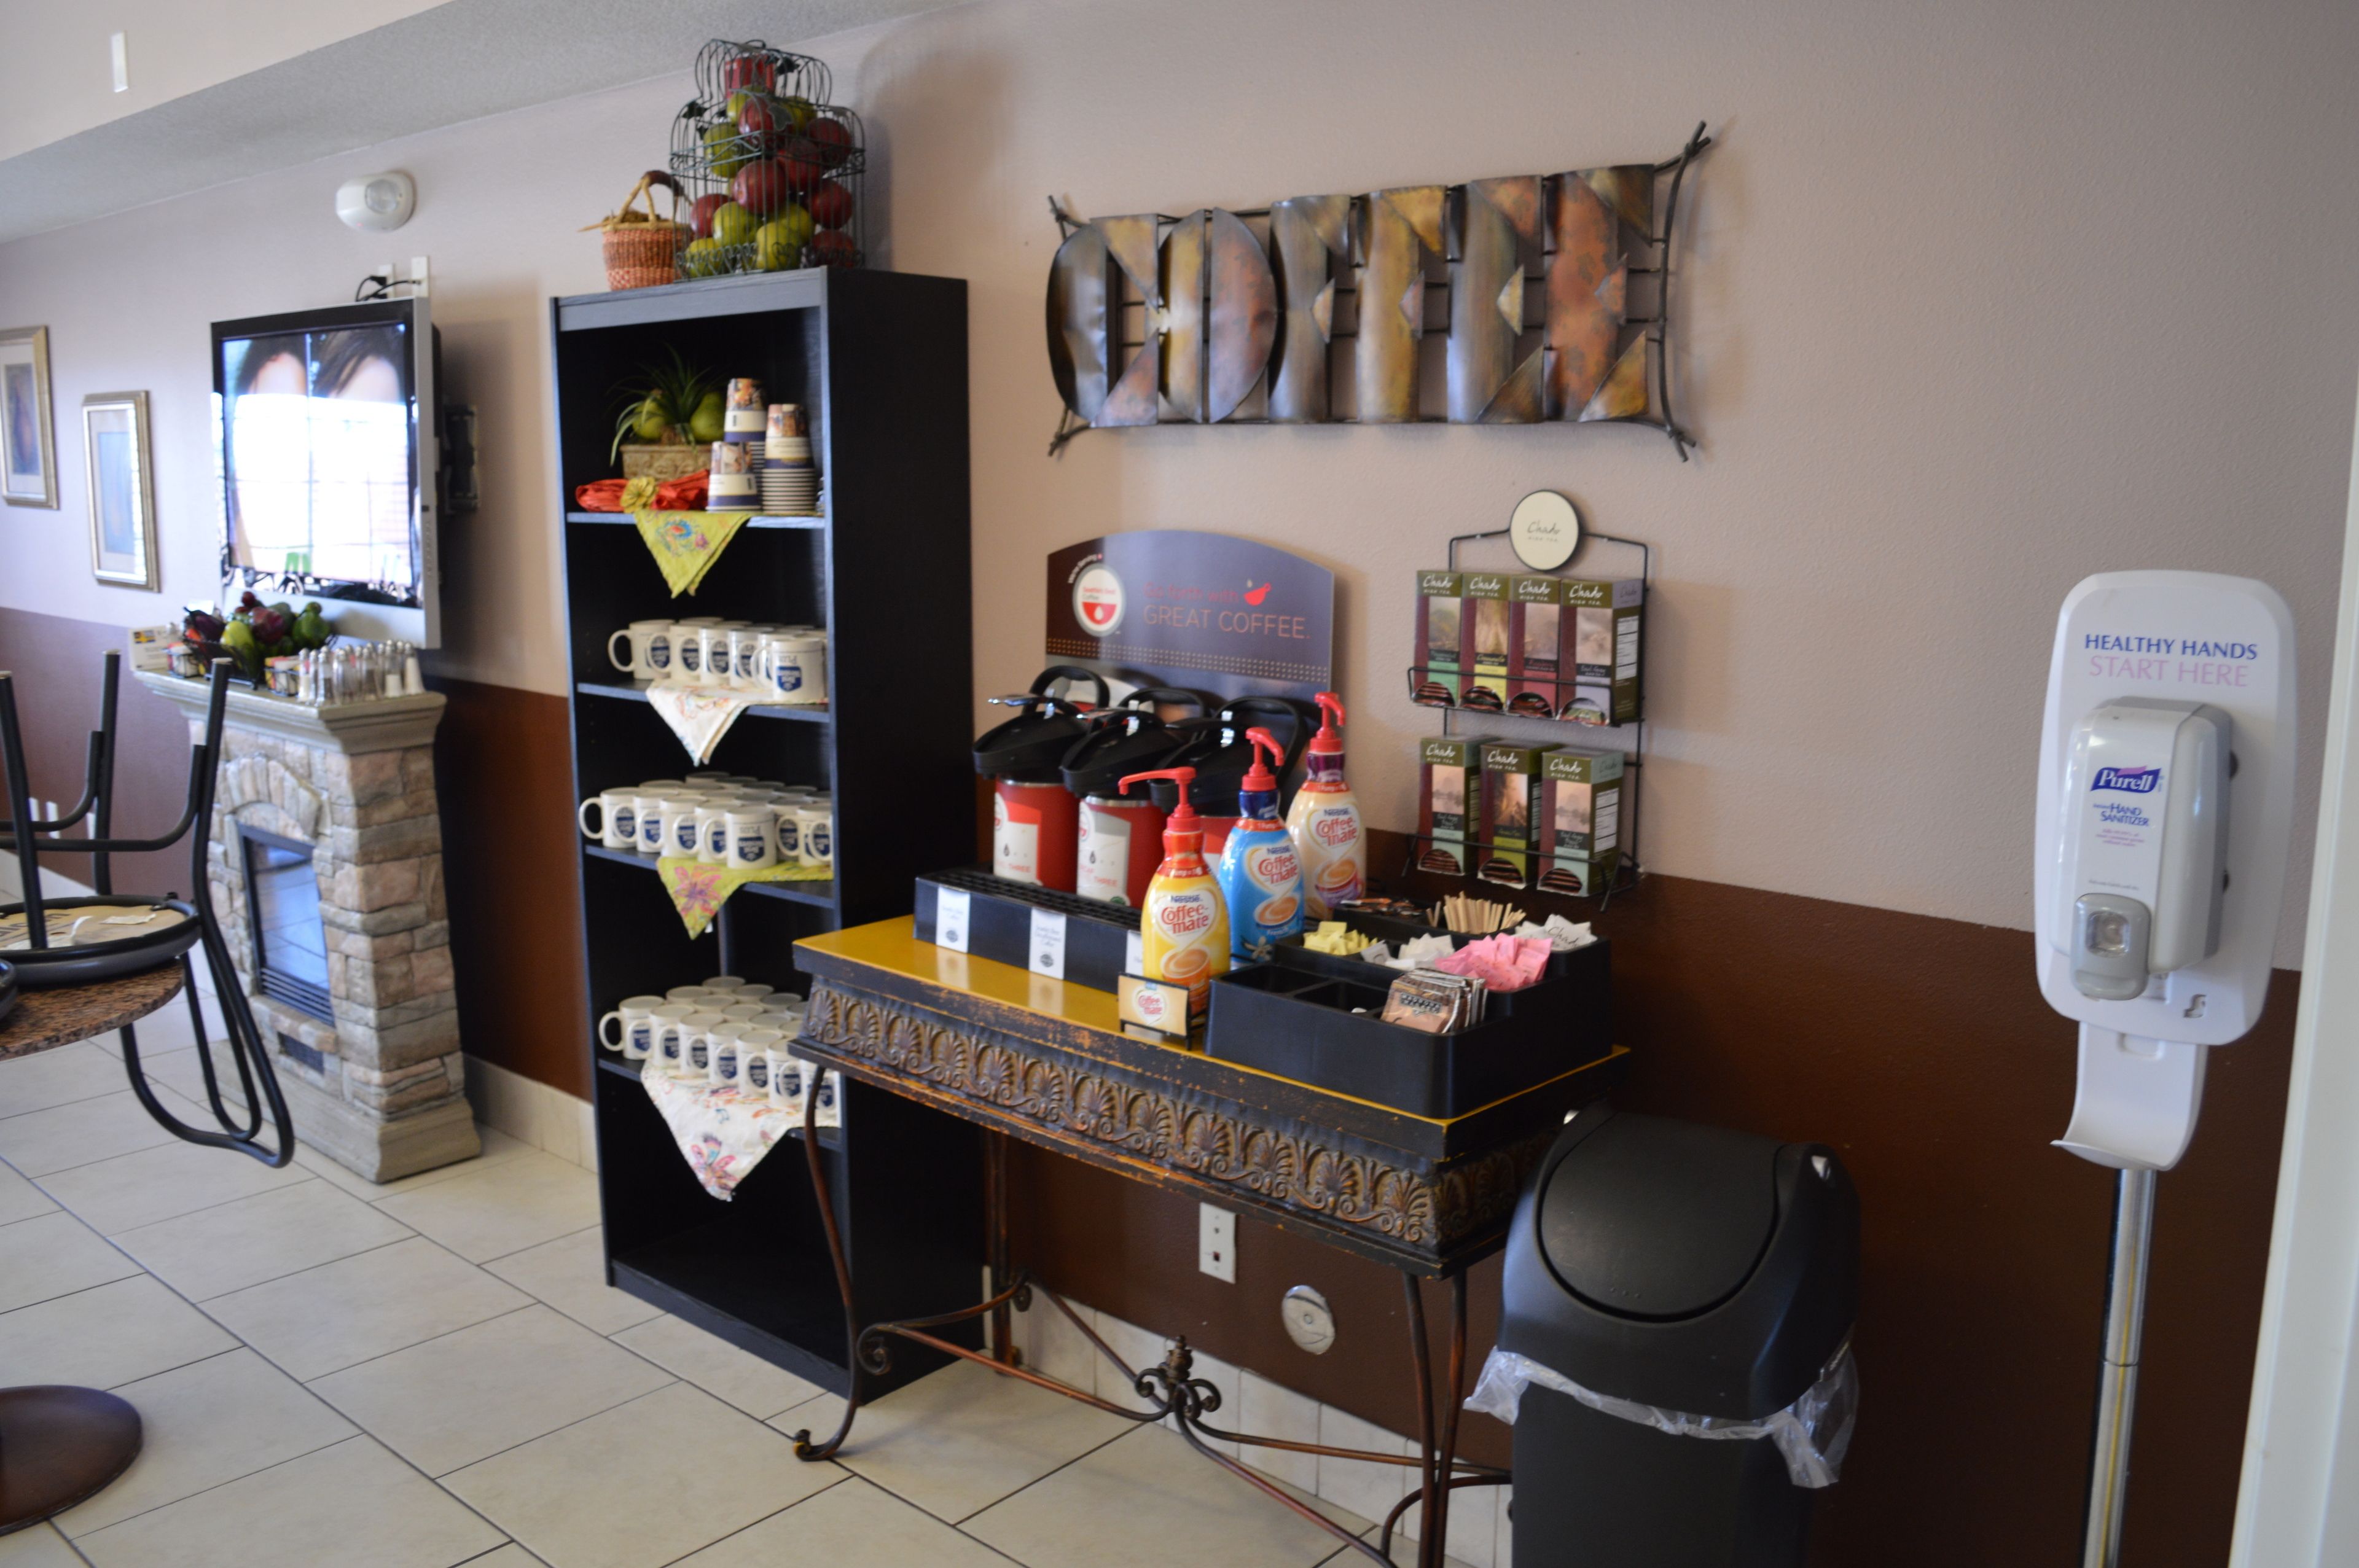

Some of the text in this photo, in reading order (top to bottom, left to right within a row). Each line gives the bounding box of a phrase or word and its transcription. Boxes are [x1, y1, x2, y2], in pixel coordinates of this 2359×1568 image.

[1527, 521, 1561, 534] Chado
[1423, 574, 1453, 588] Chado
[1469, 576, 1501, 590] Chado
[1519, 579, 1551, 594] Chado
[1569, 583, 1604, 598] Chado
[1143, 604, 1212, 629] GREAT
[2084, 633, 2258, 660] HEALTHY HANDS
[2089, 655, 2249, 687] START HERE
[1426, 743, 1456, 757] Chado
[1487, 749, 1519, 765] Chado
[1549, 757, 1582, 773] Chado
[2098, 769, 2154, 791] Purell
[2110, 803, 2142, 816] HAND
[2100, 811, 2150, 826] SANITIZER
[1327, 829, 1357, 846] mate
[1270, 865, 1297, 884] mate
[1173, 915, 1209, 934] mate
